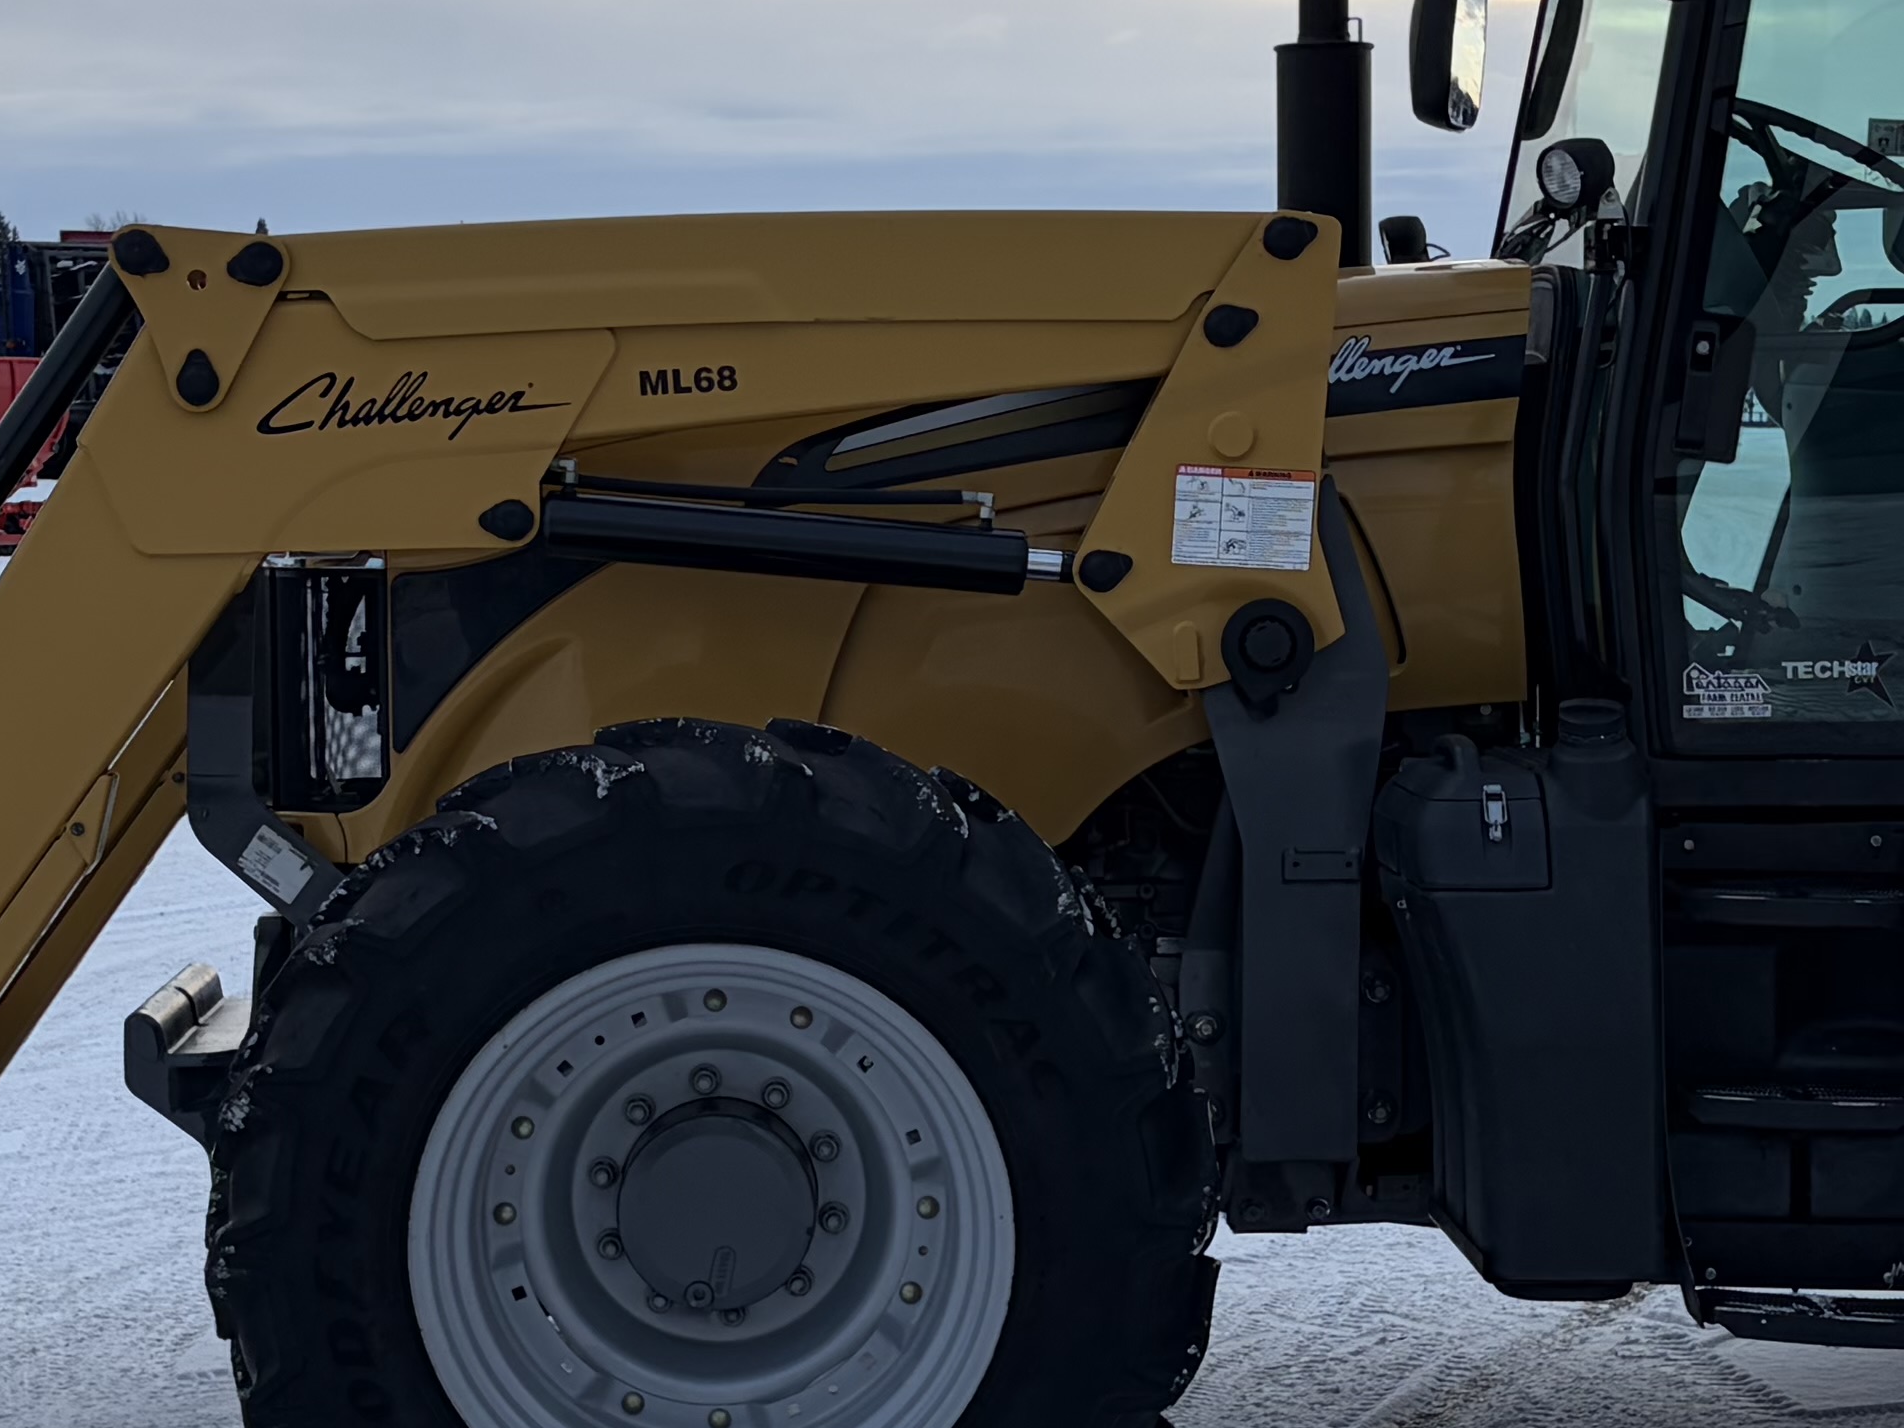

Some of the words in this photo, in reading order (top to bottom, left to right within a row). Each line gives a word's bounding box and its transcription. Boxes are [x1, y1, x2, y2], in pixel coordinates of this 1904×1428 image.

[638, 364, 738, 397] ML68
[1327, 335, 1496, 394] llenger
[255, 371, 572, 441] Challenger
[722, 856, 1076, 1103] OPTITRAC
